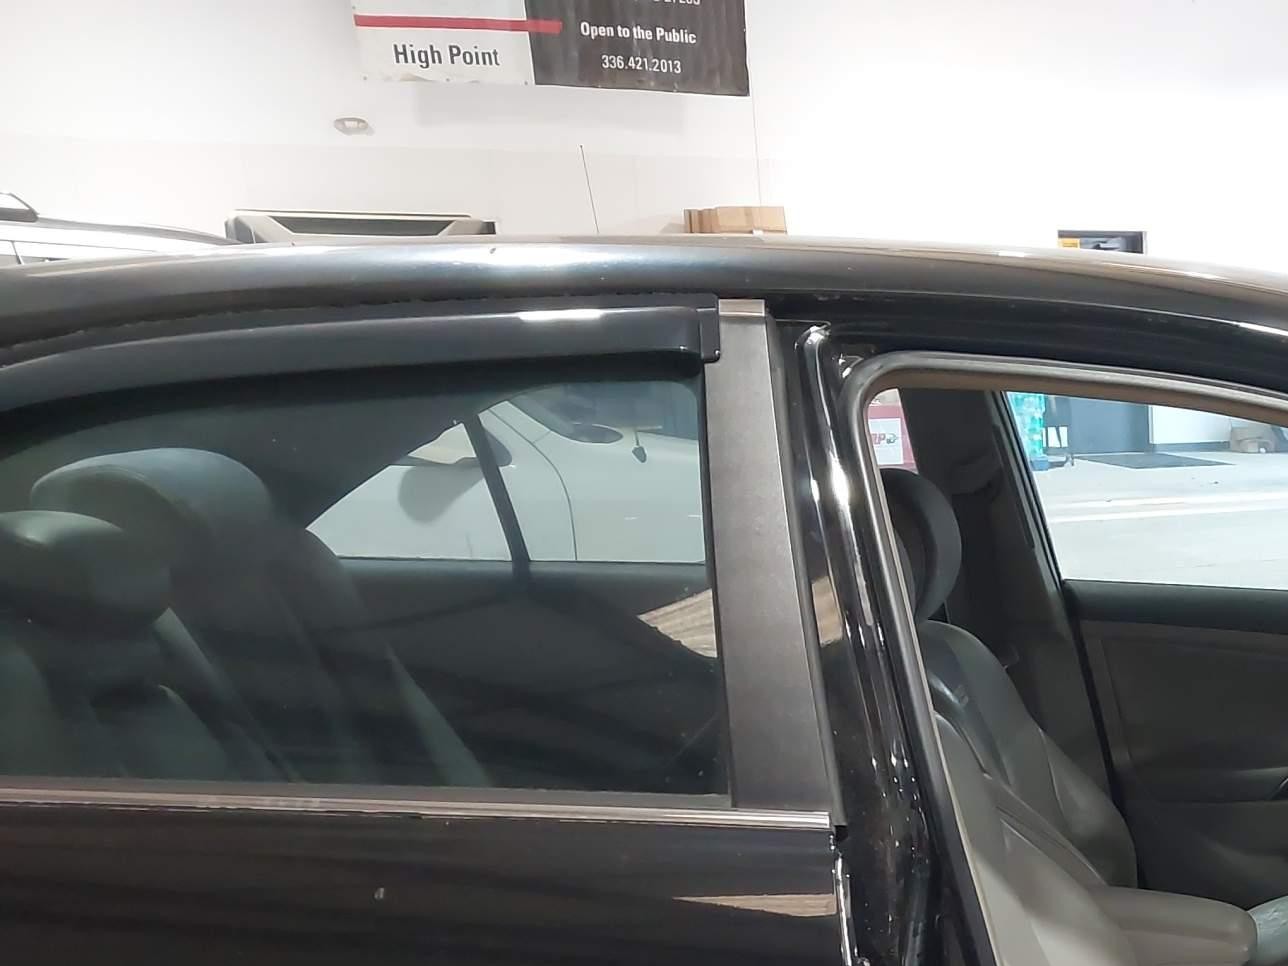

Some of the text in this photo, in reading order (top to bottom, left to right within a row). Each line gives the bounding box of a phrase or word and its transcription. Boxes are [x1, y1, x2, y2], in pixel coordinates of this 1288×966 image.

[580, 21, 697, 44] Open to the Public
[393, 43, 500, 69] High Point
[601, 54, 682, 74] 336.421.2013
